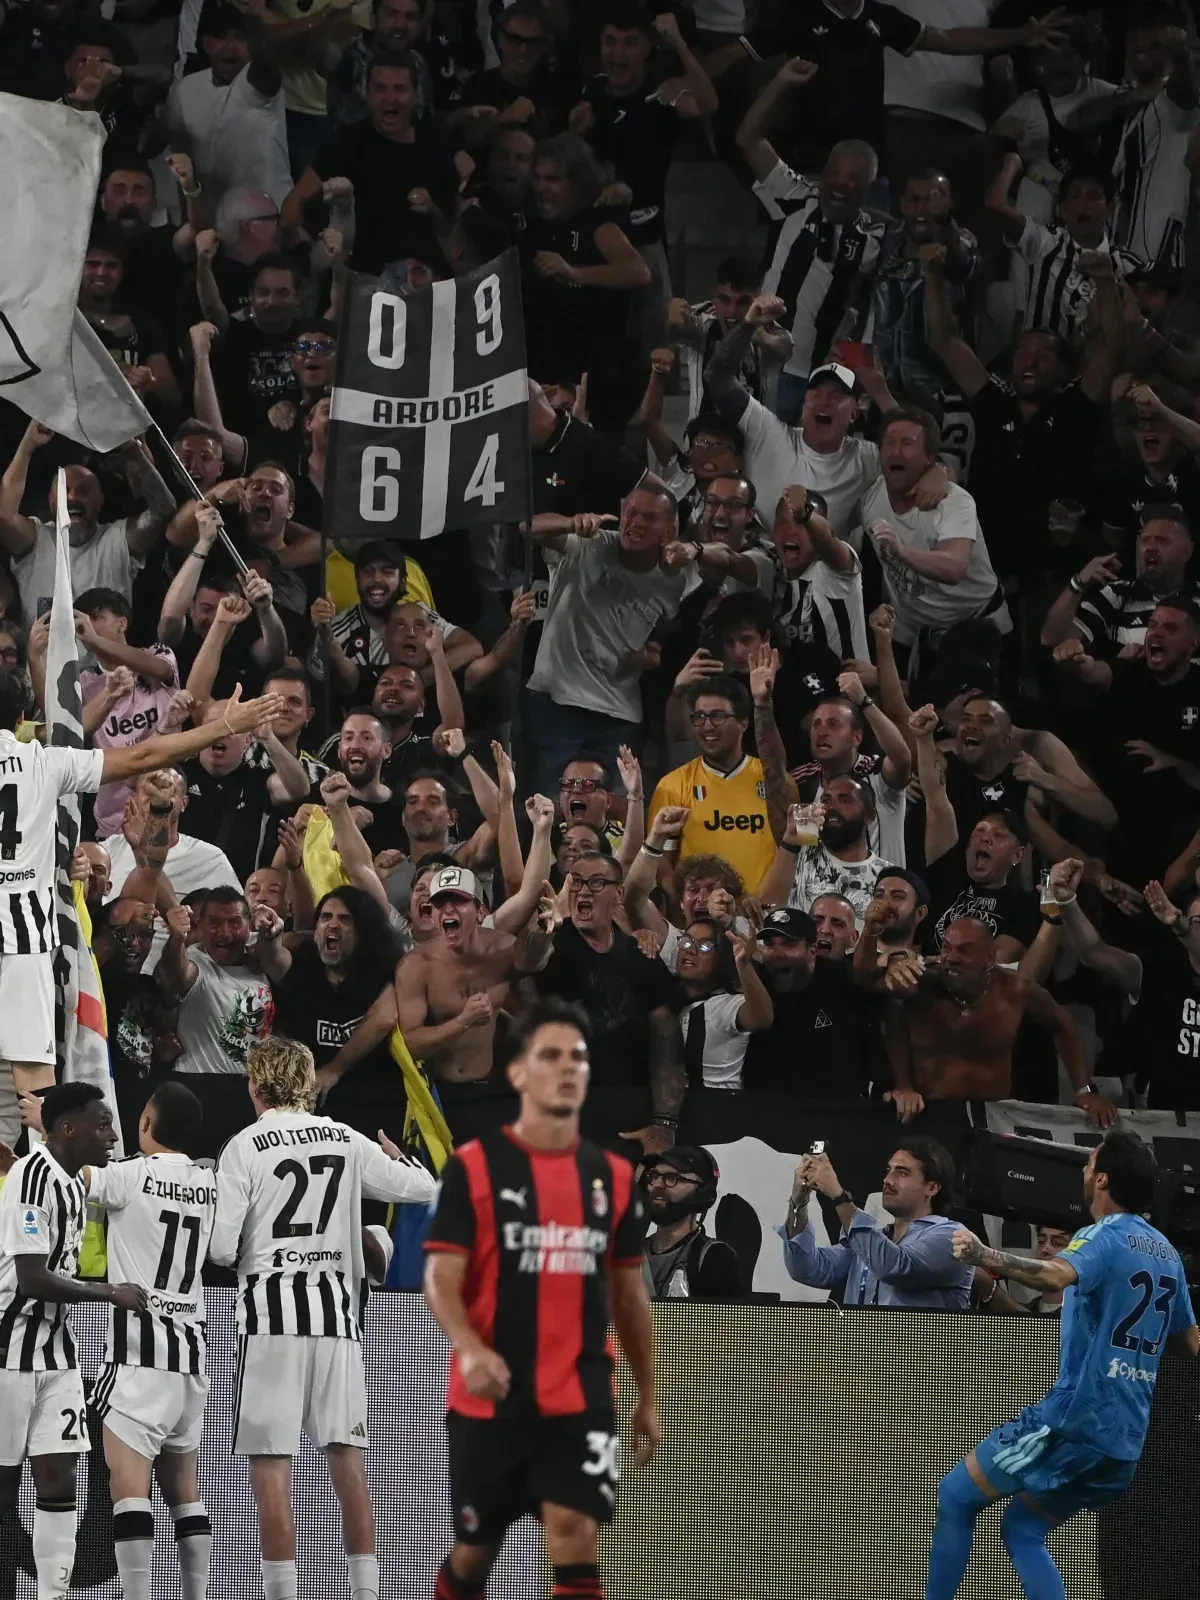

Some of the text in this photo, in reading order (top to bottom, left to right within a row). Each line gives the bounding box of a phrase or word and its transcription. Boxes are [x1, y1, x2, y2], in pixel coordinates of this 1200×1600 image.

[474, 273, 504, 357] 9
[373, 384, 495, 425] ARDORE
[359, 433, 505, 522] 6 4
[105, 706, 159, 737] Jeep
[704, 809, 765, 834] Jeep
[252, 1126, 350, 1152] WOLTEMADE
[272, 1154, 346, 1239] 27
[1007, 1170, 1035, 1183] Canon
[153, 1209, 201, 1295] 11
[1110, 1269, 1178, 1356] 23
